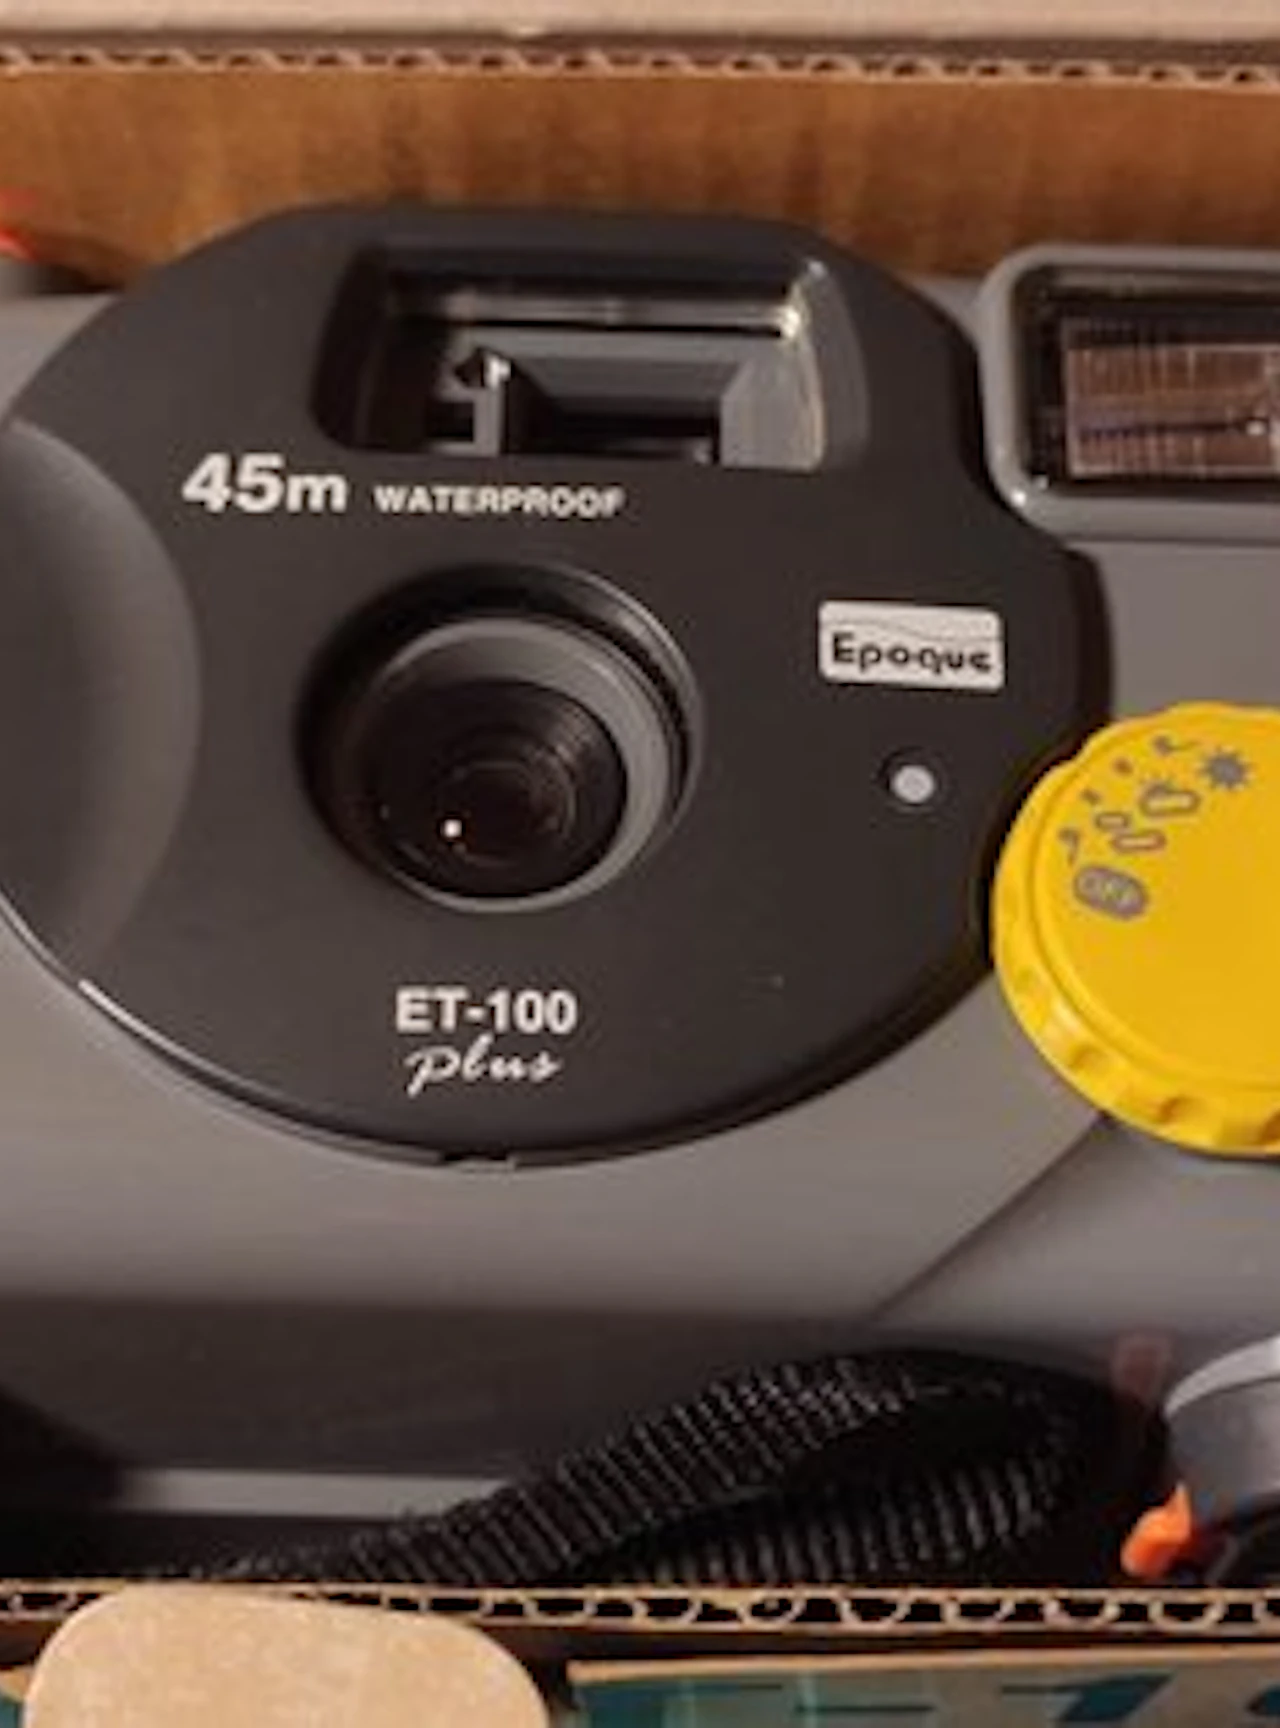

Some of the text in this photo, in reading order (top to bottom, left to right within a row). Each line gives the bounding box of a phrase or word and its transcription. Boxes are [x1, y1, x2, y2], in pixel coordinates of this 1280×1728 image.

[181, 452, 626, 520] 45m WATERPROOF
[832, 631, 992, 676] Epoque
[394, 984, 579, 1035] ET-100
